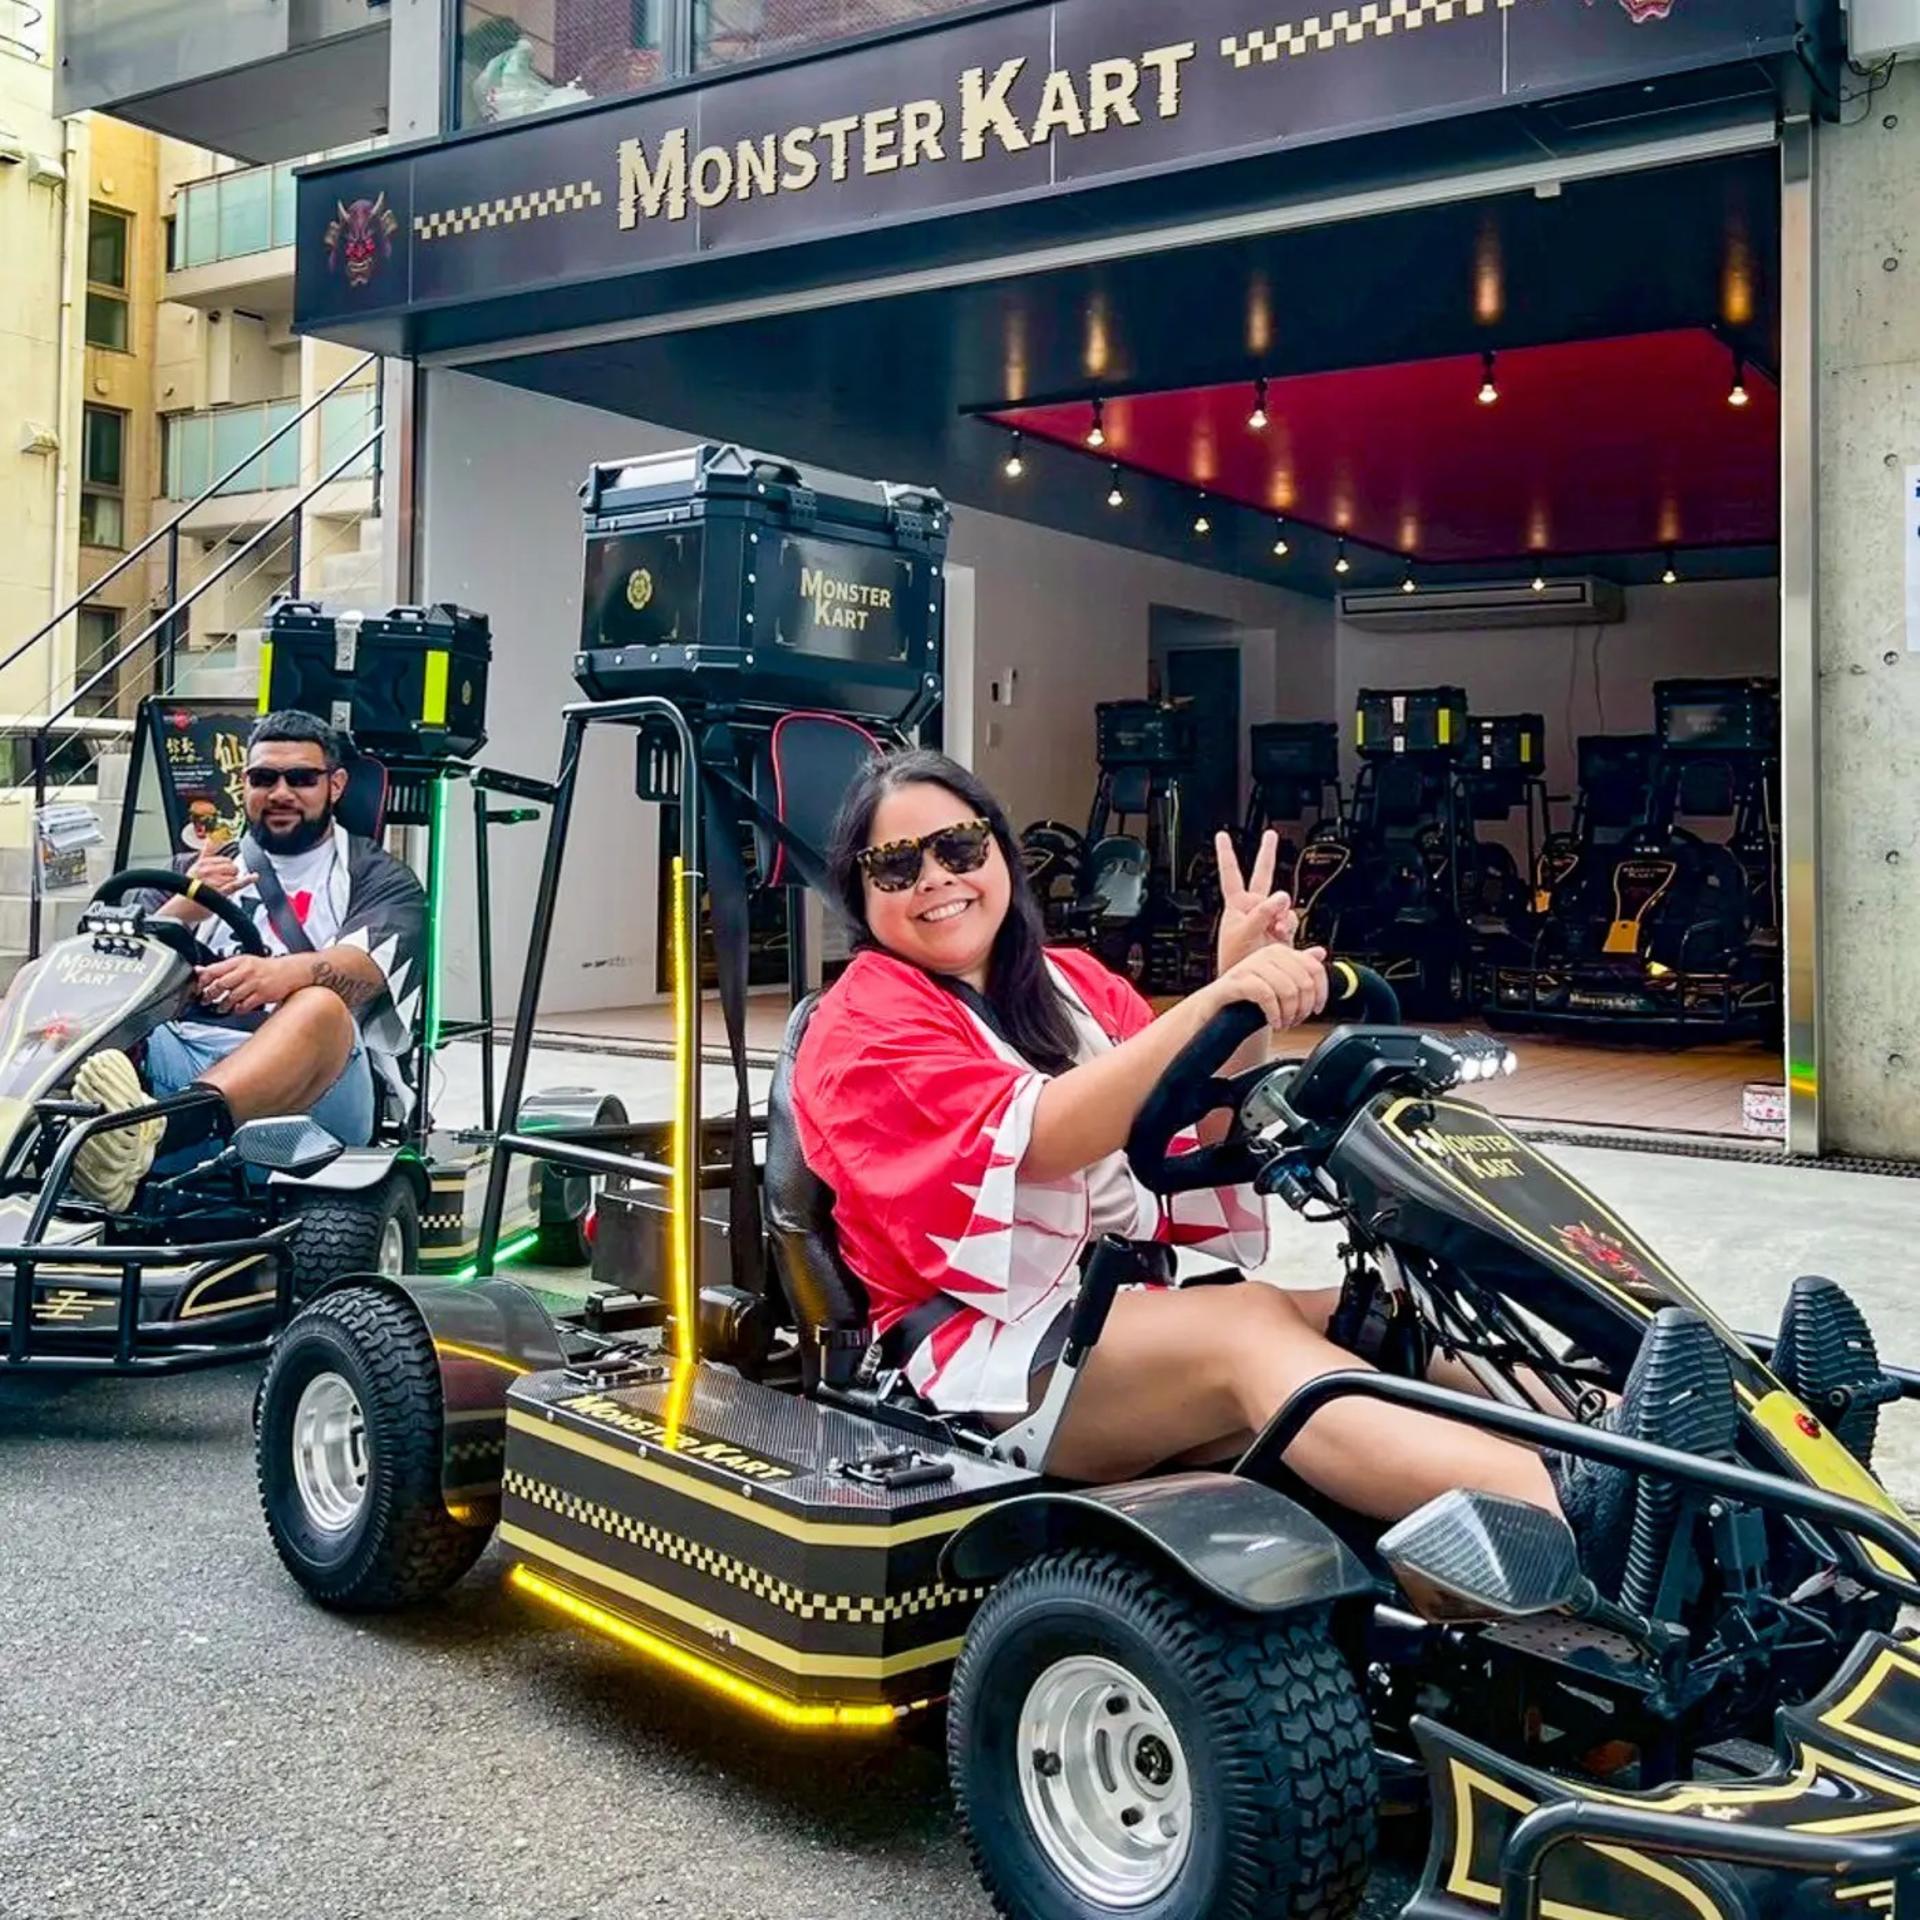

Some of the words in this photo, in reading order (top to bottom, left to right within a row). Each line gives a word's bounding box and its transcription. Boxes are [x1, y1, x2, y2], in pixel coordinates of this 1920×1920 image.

[617, 99, 946, 230] MONSTER
[958, 41, 1196, 161] KART
[800, 566, 891, 608] MONSTER
[814, 596, 869, 631] KART
[57, 953, 146, 974] MONSTER
[61, 967, 118, 986] KART
[1449, 1149, 1525, 1179] KART
[687, 1443, 792, 1478] KART
